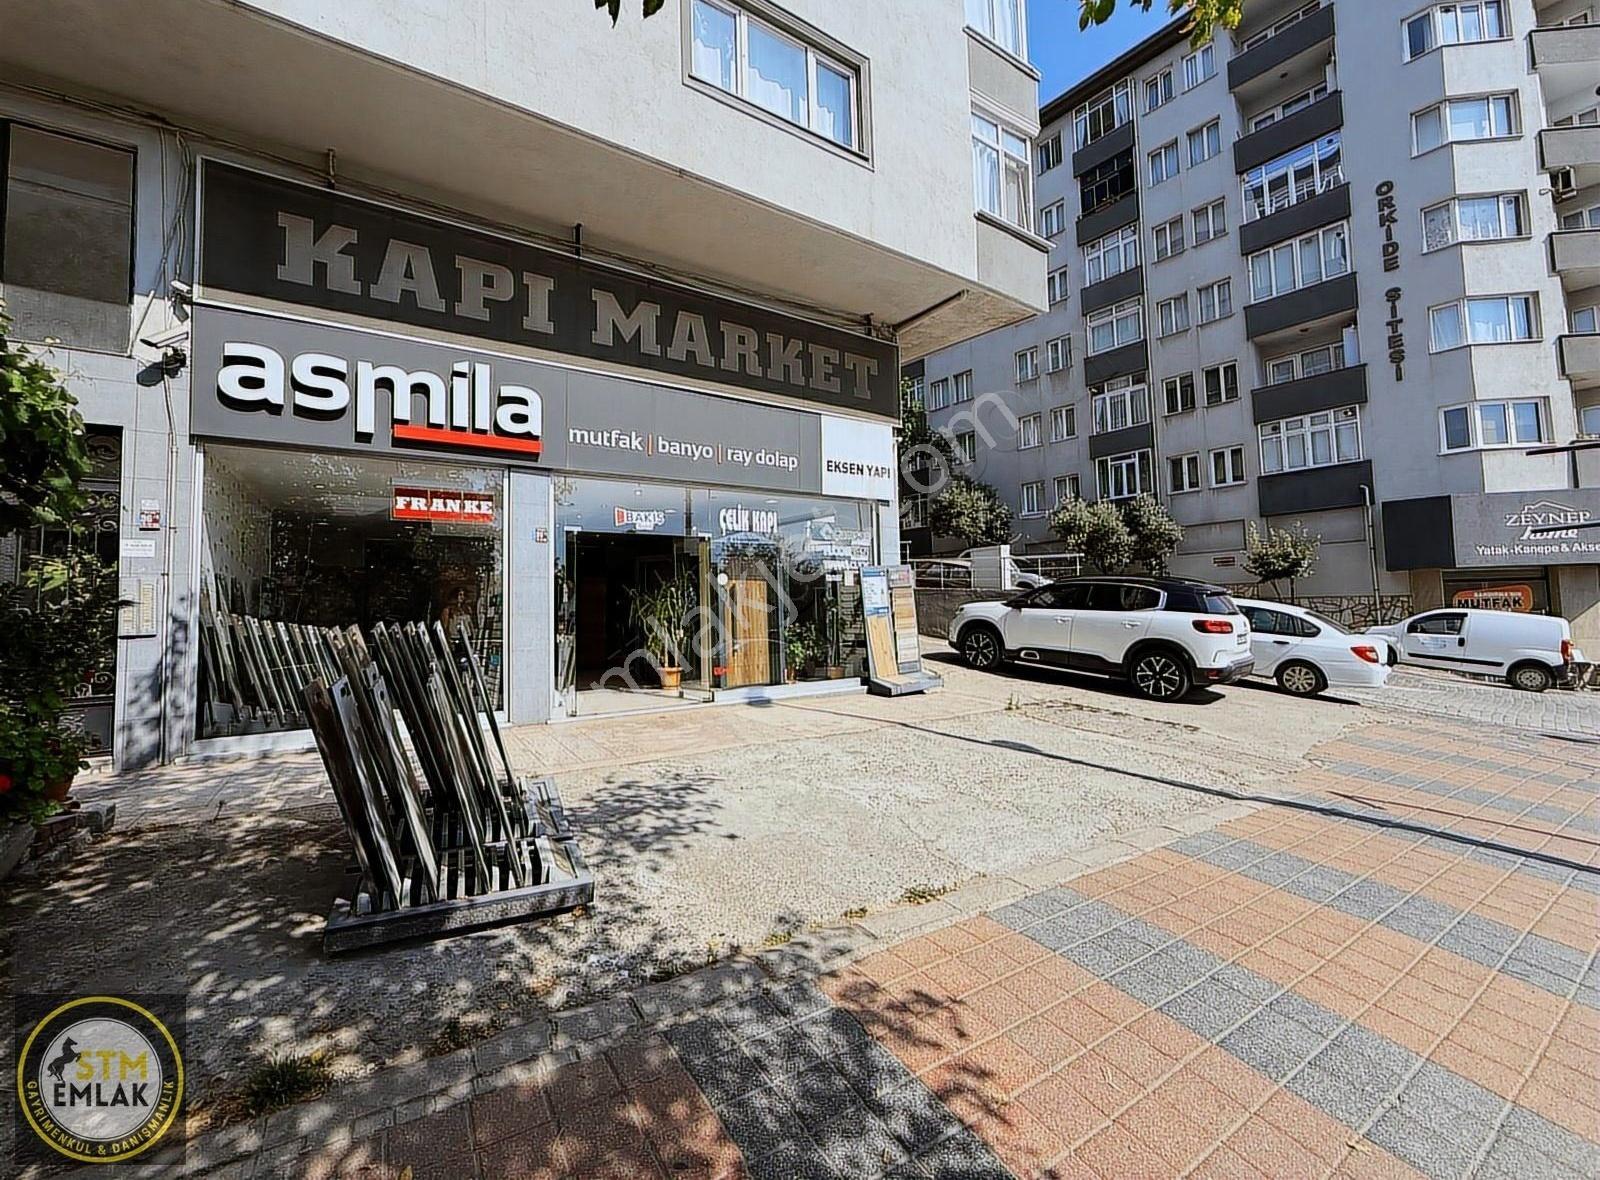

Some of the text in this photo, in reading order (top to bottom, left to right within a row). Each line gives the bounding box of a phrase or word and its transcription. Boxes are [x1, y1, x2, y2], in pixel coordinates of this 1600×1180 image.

[276, 211, 879, 399] KAPI MARKET
[217, 341, 544, 441] asmila
[568, 427, 798, 471] mutfak banyo ray dolap
[826, 459, 891, 479] EKSEN YAPI
[395, 495, 493, 515] FRANKE
[1505, 511, 1591, 526] ZEYNEP
[1456, 597, 1523, 609] MUTFAK
